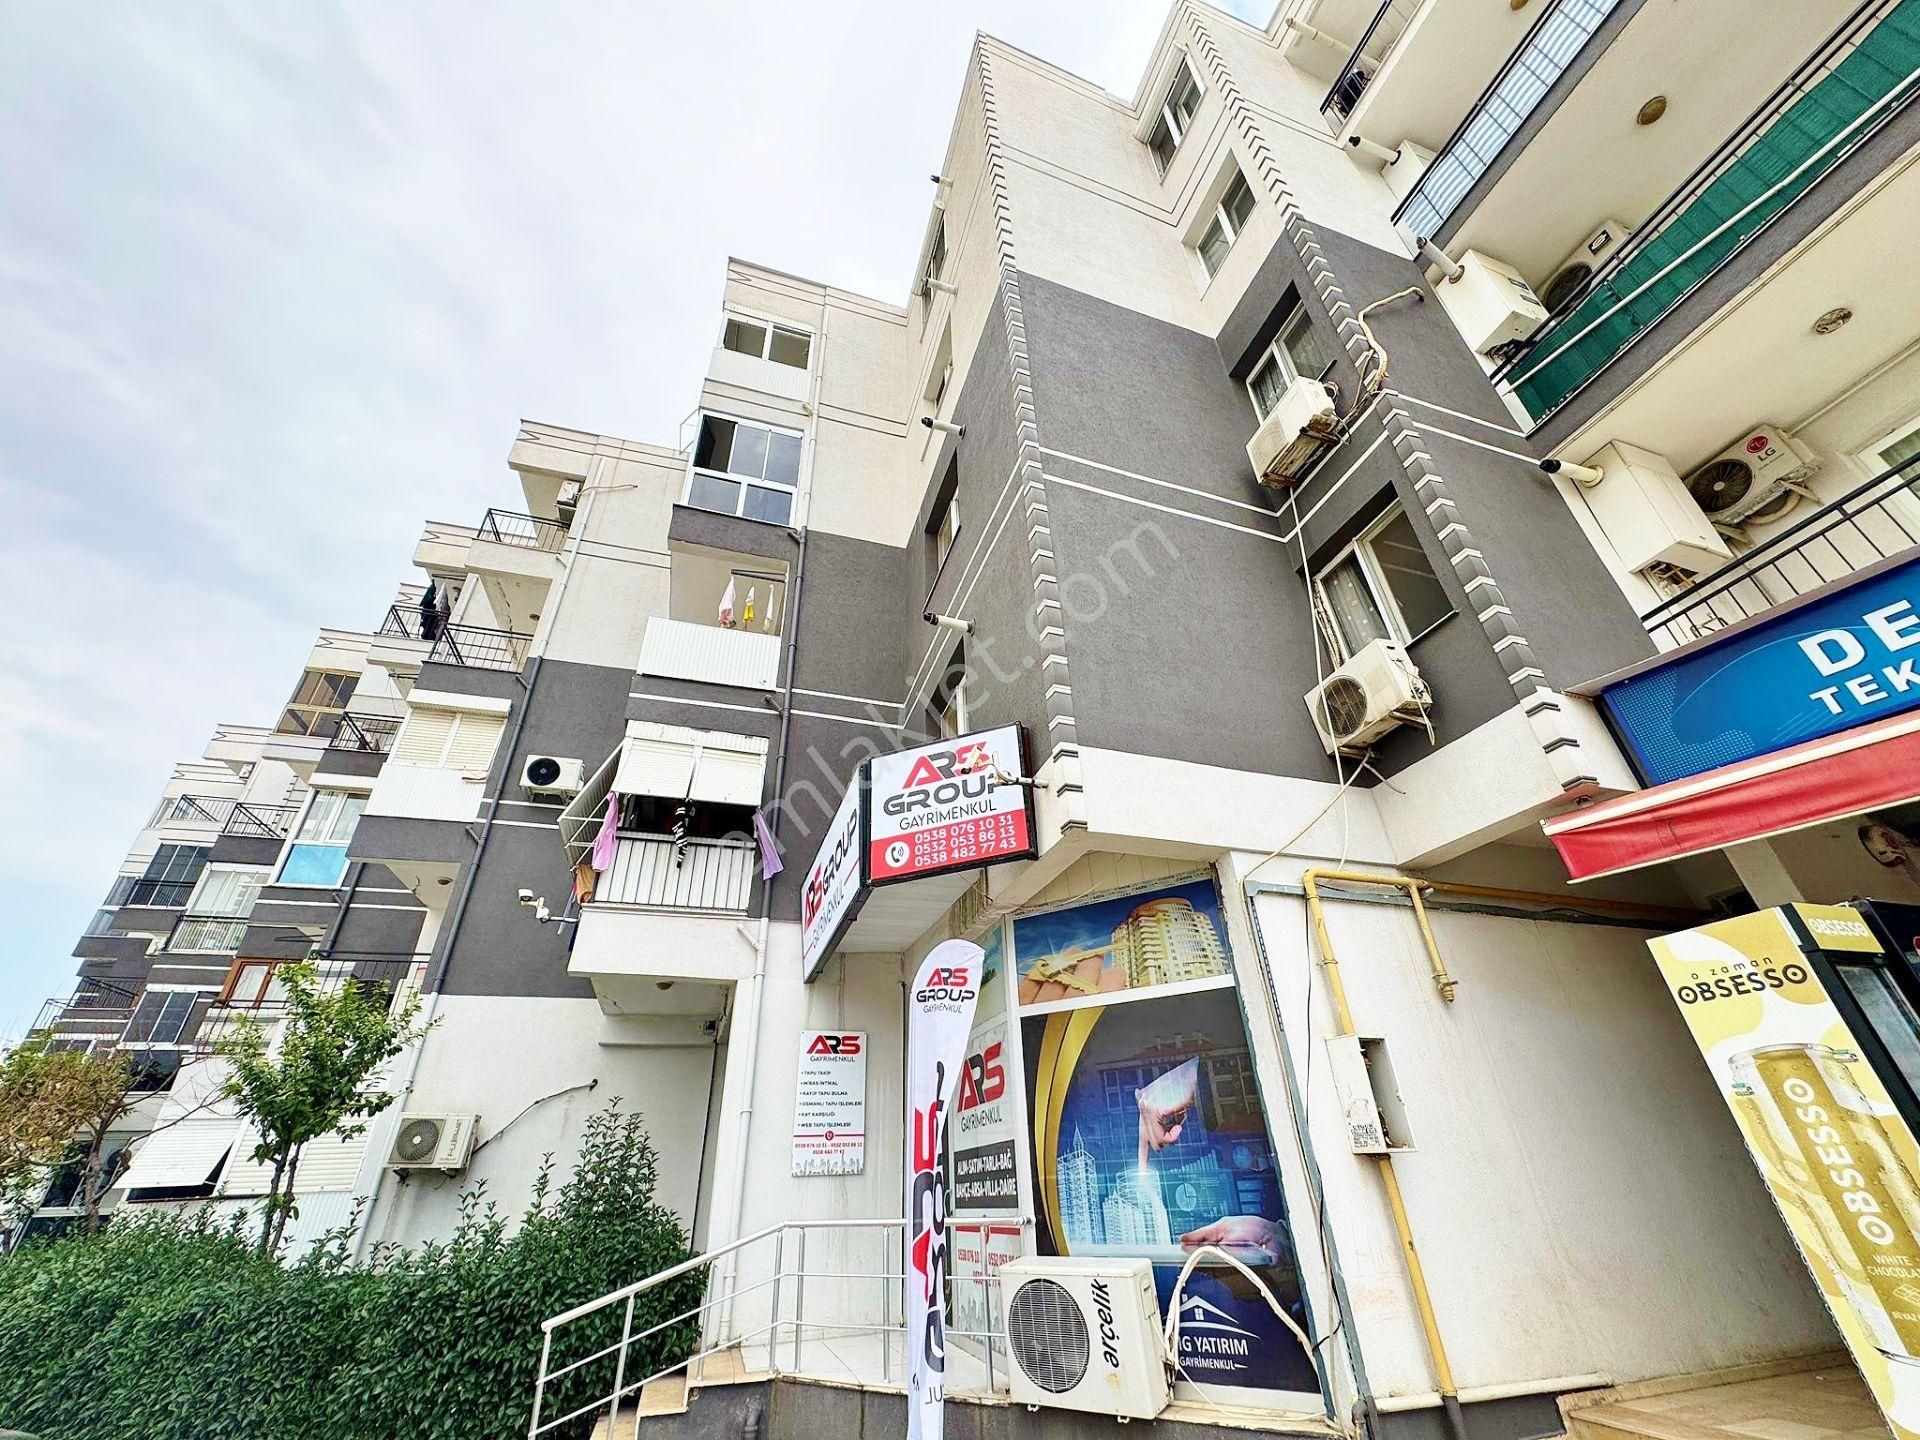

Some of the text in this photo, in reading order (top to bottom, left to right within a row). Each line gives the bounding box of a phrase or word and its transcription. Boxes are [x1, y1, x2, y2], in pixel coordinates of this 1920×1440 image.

[1757, 446, 1776, 461] LG
[903, 741, 988, 789] ARS
[900, 799, 996, 830] GAYRİMENKUL
[915, 814, 1014, 844] 0538 076 10 31
[915, 826, 1015, 855] 0532 053 86 13
[915, 838, 1016, 867] 0538 482 77 43
[804, 808, 857, 935] ARS GROUP
[926, 967, 969, 988] ARS
[1710, 956, 1773, 976] zaman
[916, 988, 975, 1003] GROUP
[1677, 964, 1808, 1005] OBSESSO
[806, 1035, 861, 1055] ARS
[957, 1041, 1007, 1113] ARS
[961, 1109, 1003, 1133] GAYRİMENKUL
[1783, 1077, 1895, 1246] OBSESSO
[1872, 1254, 1913, 1266] WHITE
[1090, 1279, 1119, 1368] arçelik
[1194, 1336, 1249, 1356] YATIRIM
[1179, 1355, 1236, 1371] GAYRİMENKUL
